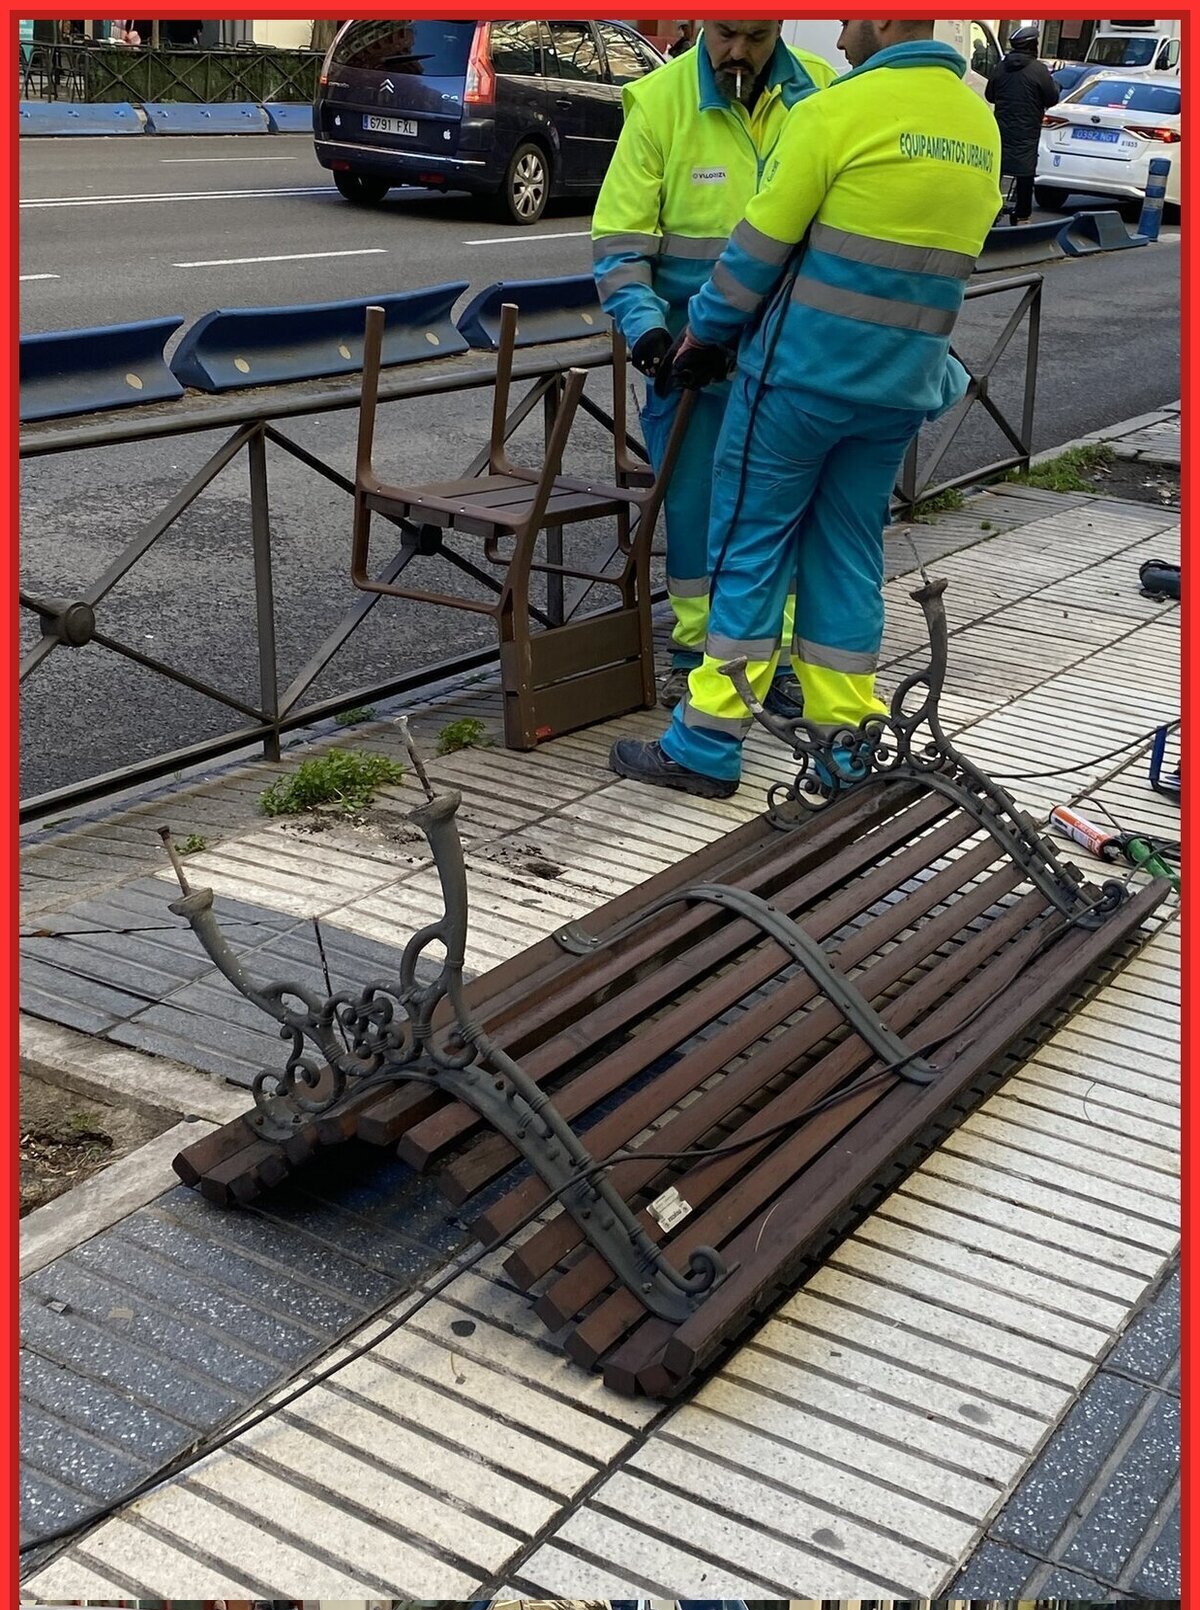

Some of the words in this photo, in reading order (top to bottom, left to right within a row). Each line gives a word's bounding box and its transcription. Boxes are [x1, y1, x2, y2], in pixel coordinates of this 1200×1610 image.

[370, 117, 392, 131] 6791
[396, 121, 415, 134] FXL
[899, 132, 965, 165] EQUIPAMIENTOS
[966, 143, 994, 173] URBANOS
